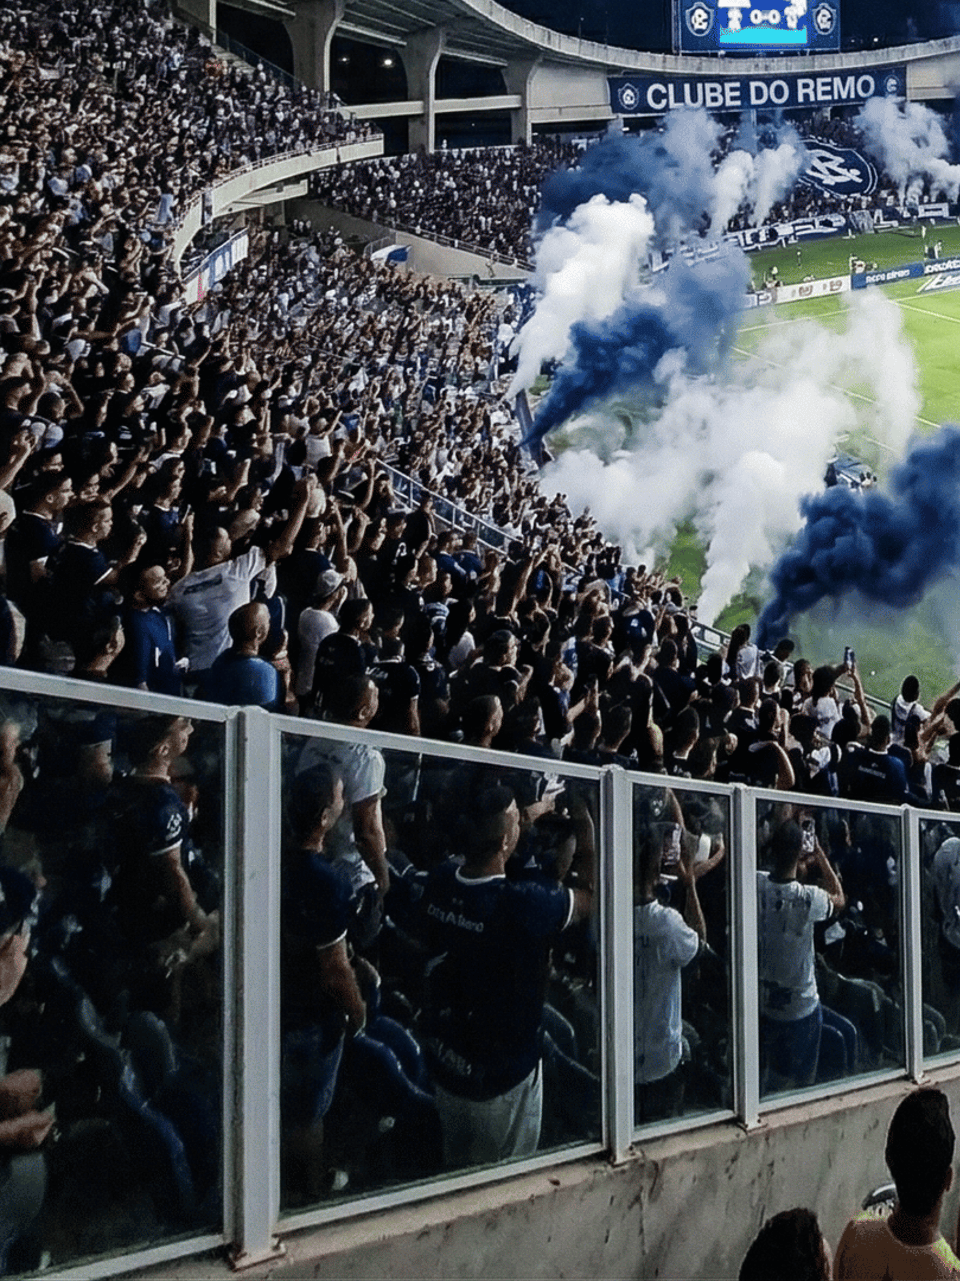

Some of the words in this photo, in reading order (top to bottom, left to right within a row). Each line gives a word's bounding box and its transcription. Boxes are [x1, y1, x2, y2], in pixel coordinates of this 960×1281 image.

[646, 82, 741, 110] CLUBE
[749, 79, 790, 105] DO
[797, 74, 876, 103] REMO
